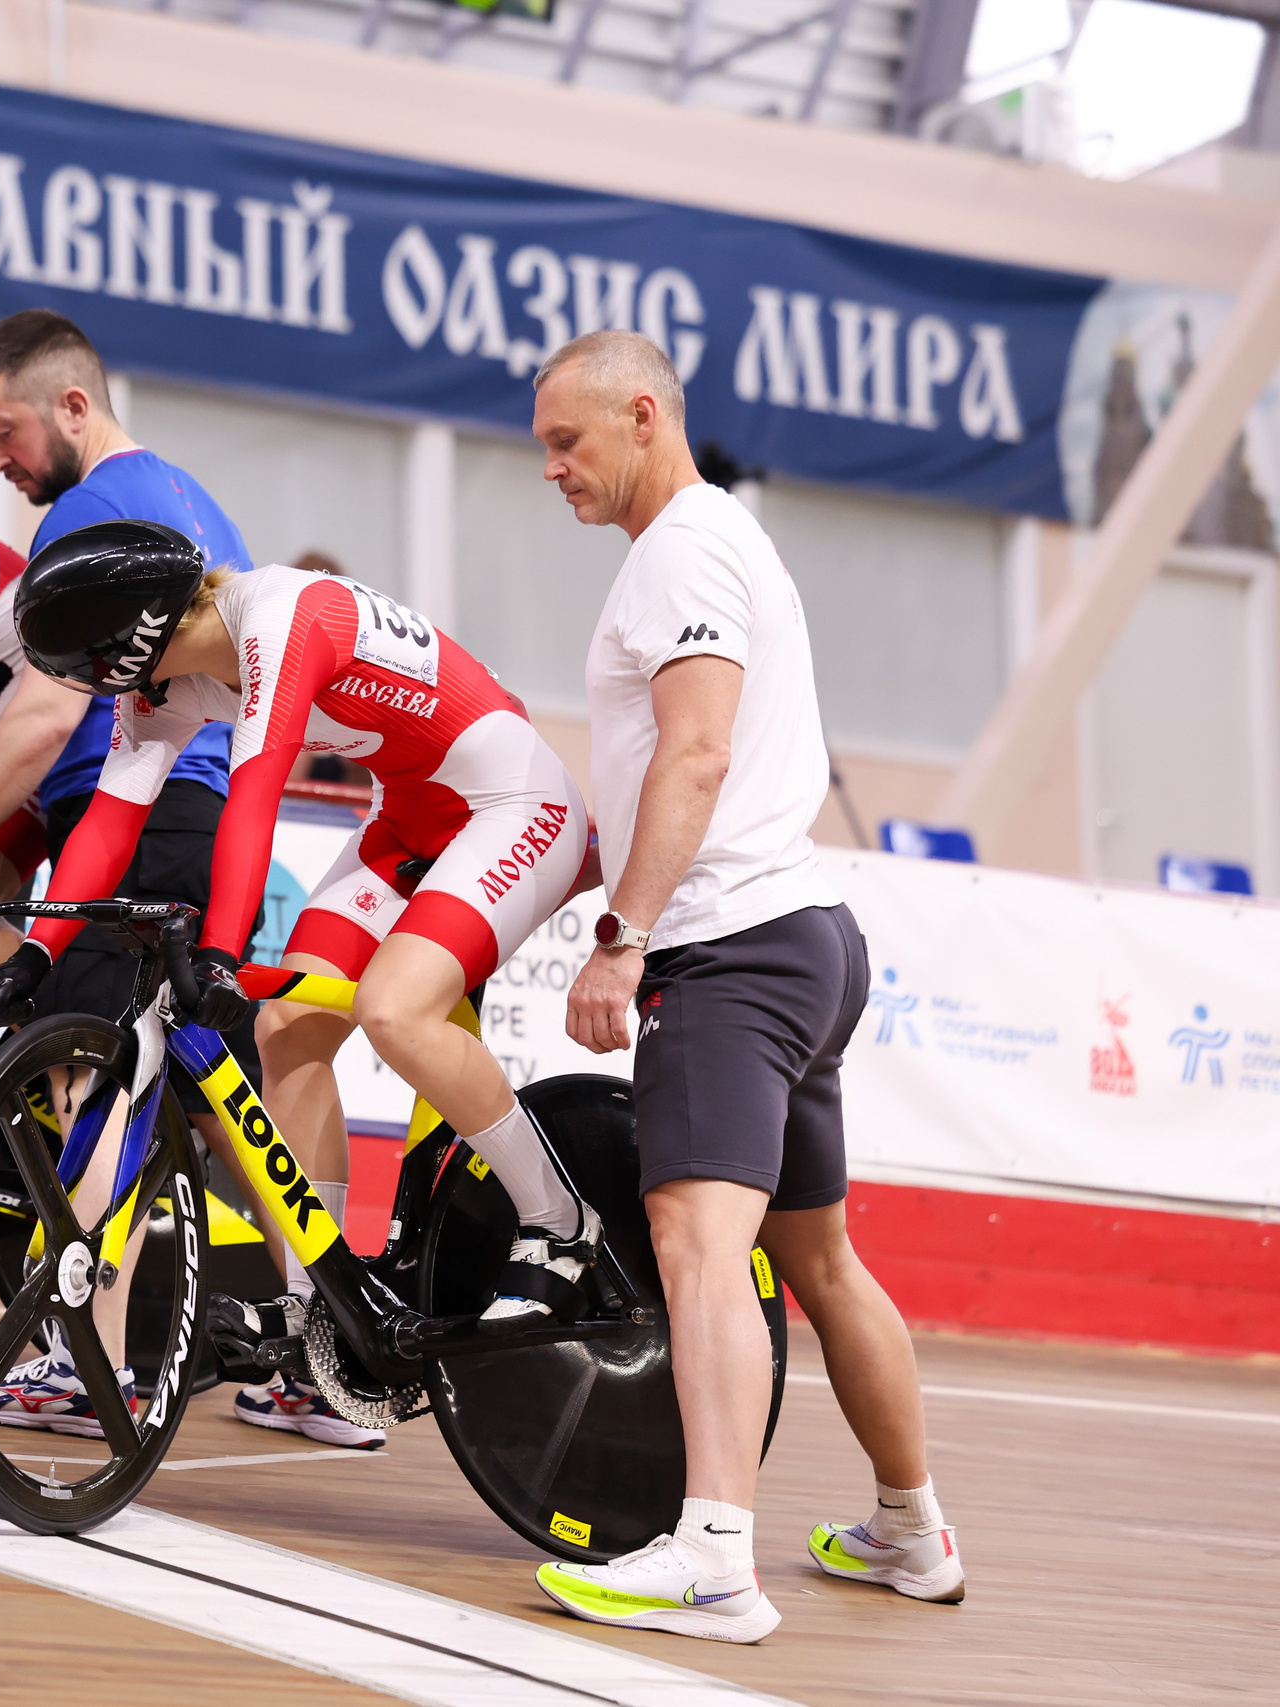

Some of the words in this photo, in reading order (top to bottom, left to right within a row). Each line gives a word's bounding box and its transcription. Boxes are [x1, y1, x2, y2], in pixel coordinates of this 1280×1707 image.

[381, 222, 707, 386] ОАЗИС
[732, 284, 1026, 445] МИРА
[102, 608, 169, 687] KASK
[244, 636, 262, 722] МОСКВА
[375, 655, 419, 675] Санкт-Петербург
[330, 675, 440, 719] МОСКВА
[477, 802, 568, 905] МОСКВА
[222, 1080, 326, 1234] LOOK
[146, 1171, 197, 1429] CORIMA
[758, 1258, 769, 1287] MAVIC
[559, 1523, 583, 1538] MAVIC
